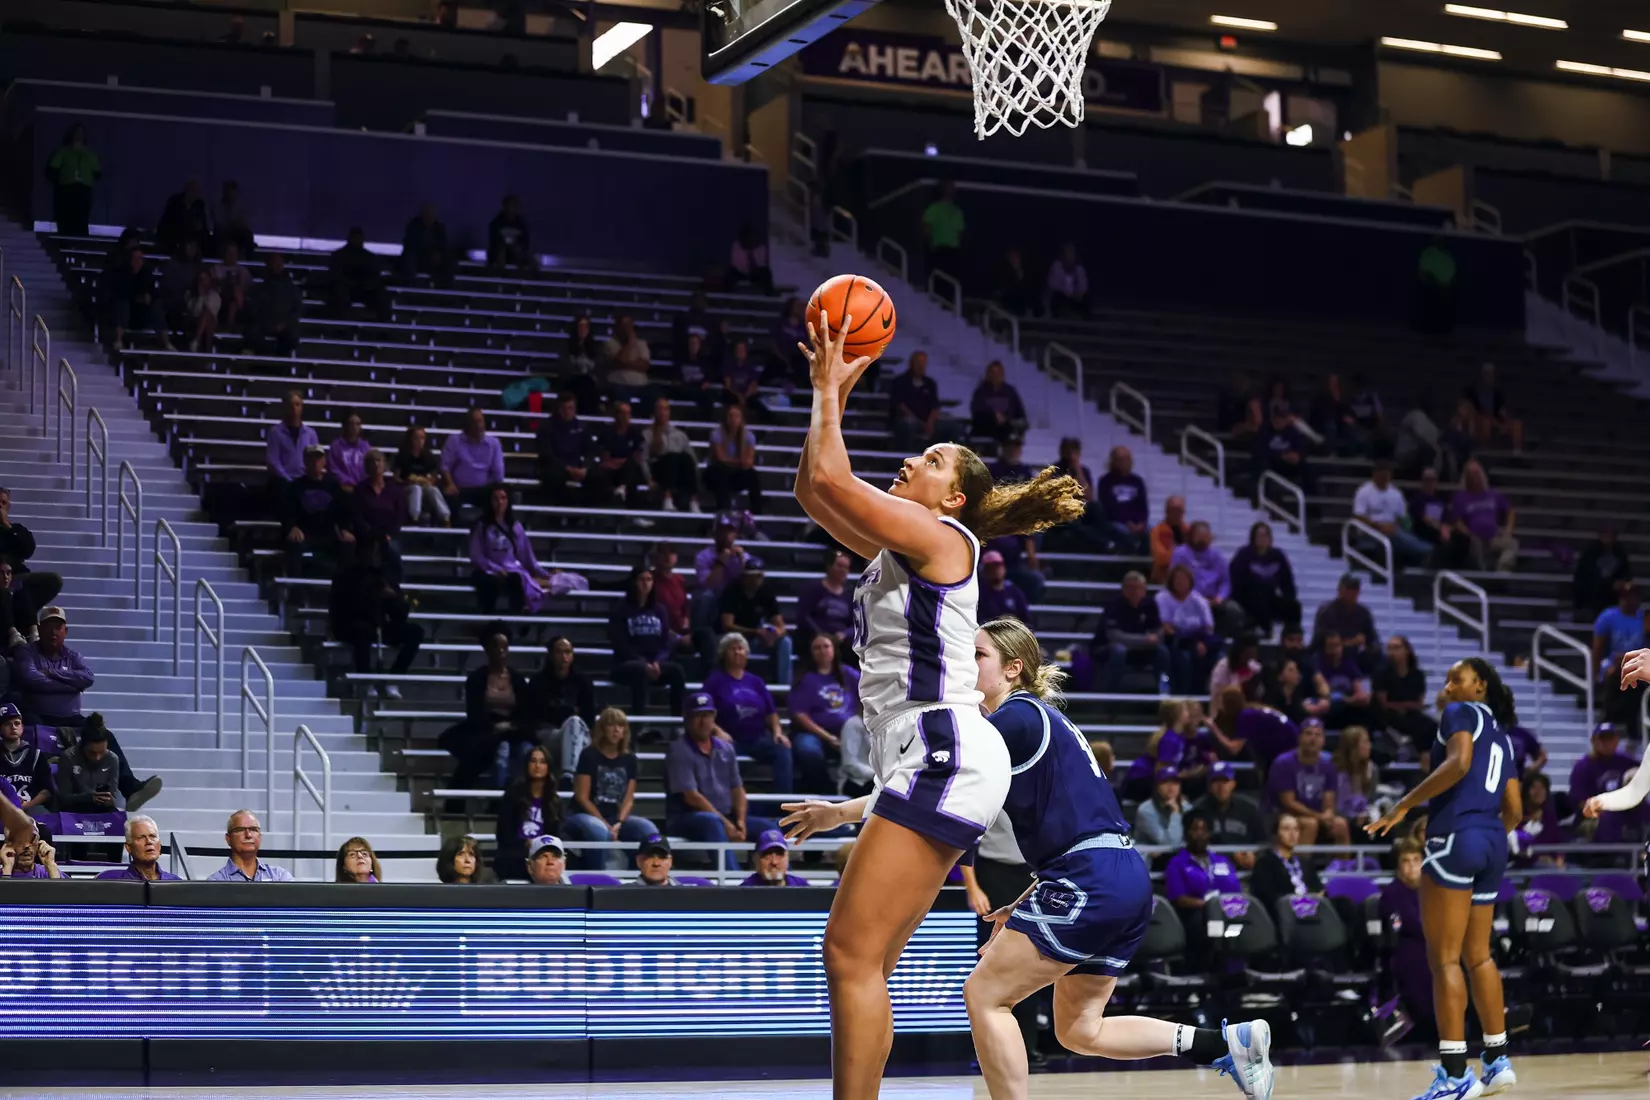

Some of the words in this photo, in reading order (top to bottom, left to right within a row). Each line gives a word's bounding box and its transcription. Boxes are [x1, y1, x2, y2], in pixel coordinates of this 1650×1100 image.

[838, 41, 1001, 90] AHEAR
[0, 774, 33, 784] STATE
[1485, 741, 1503, 794] 0
